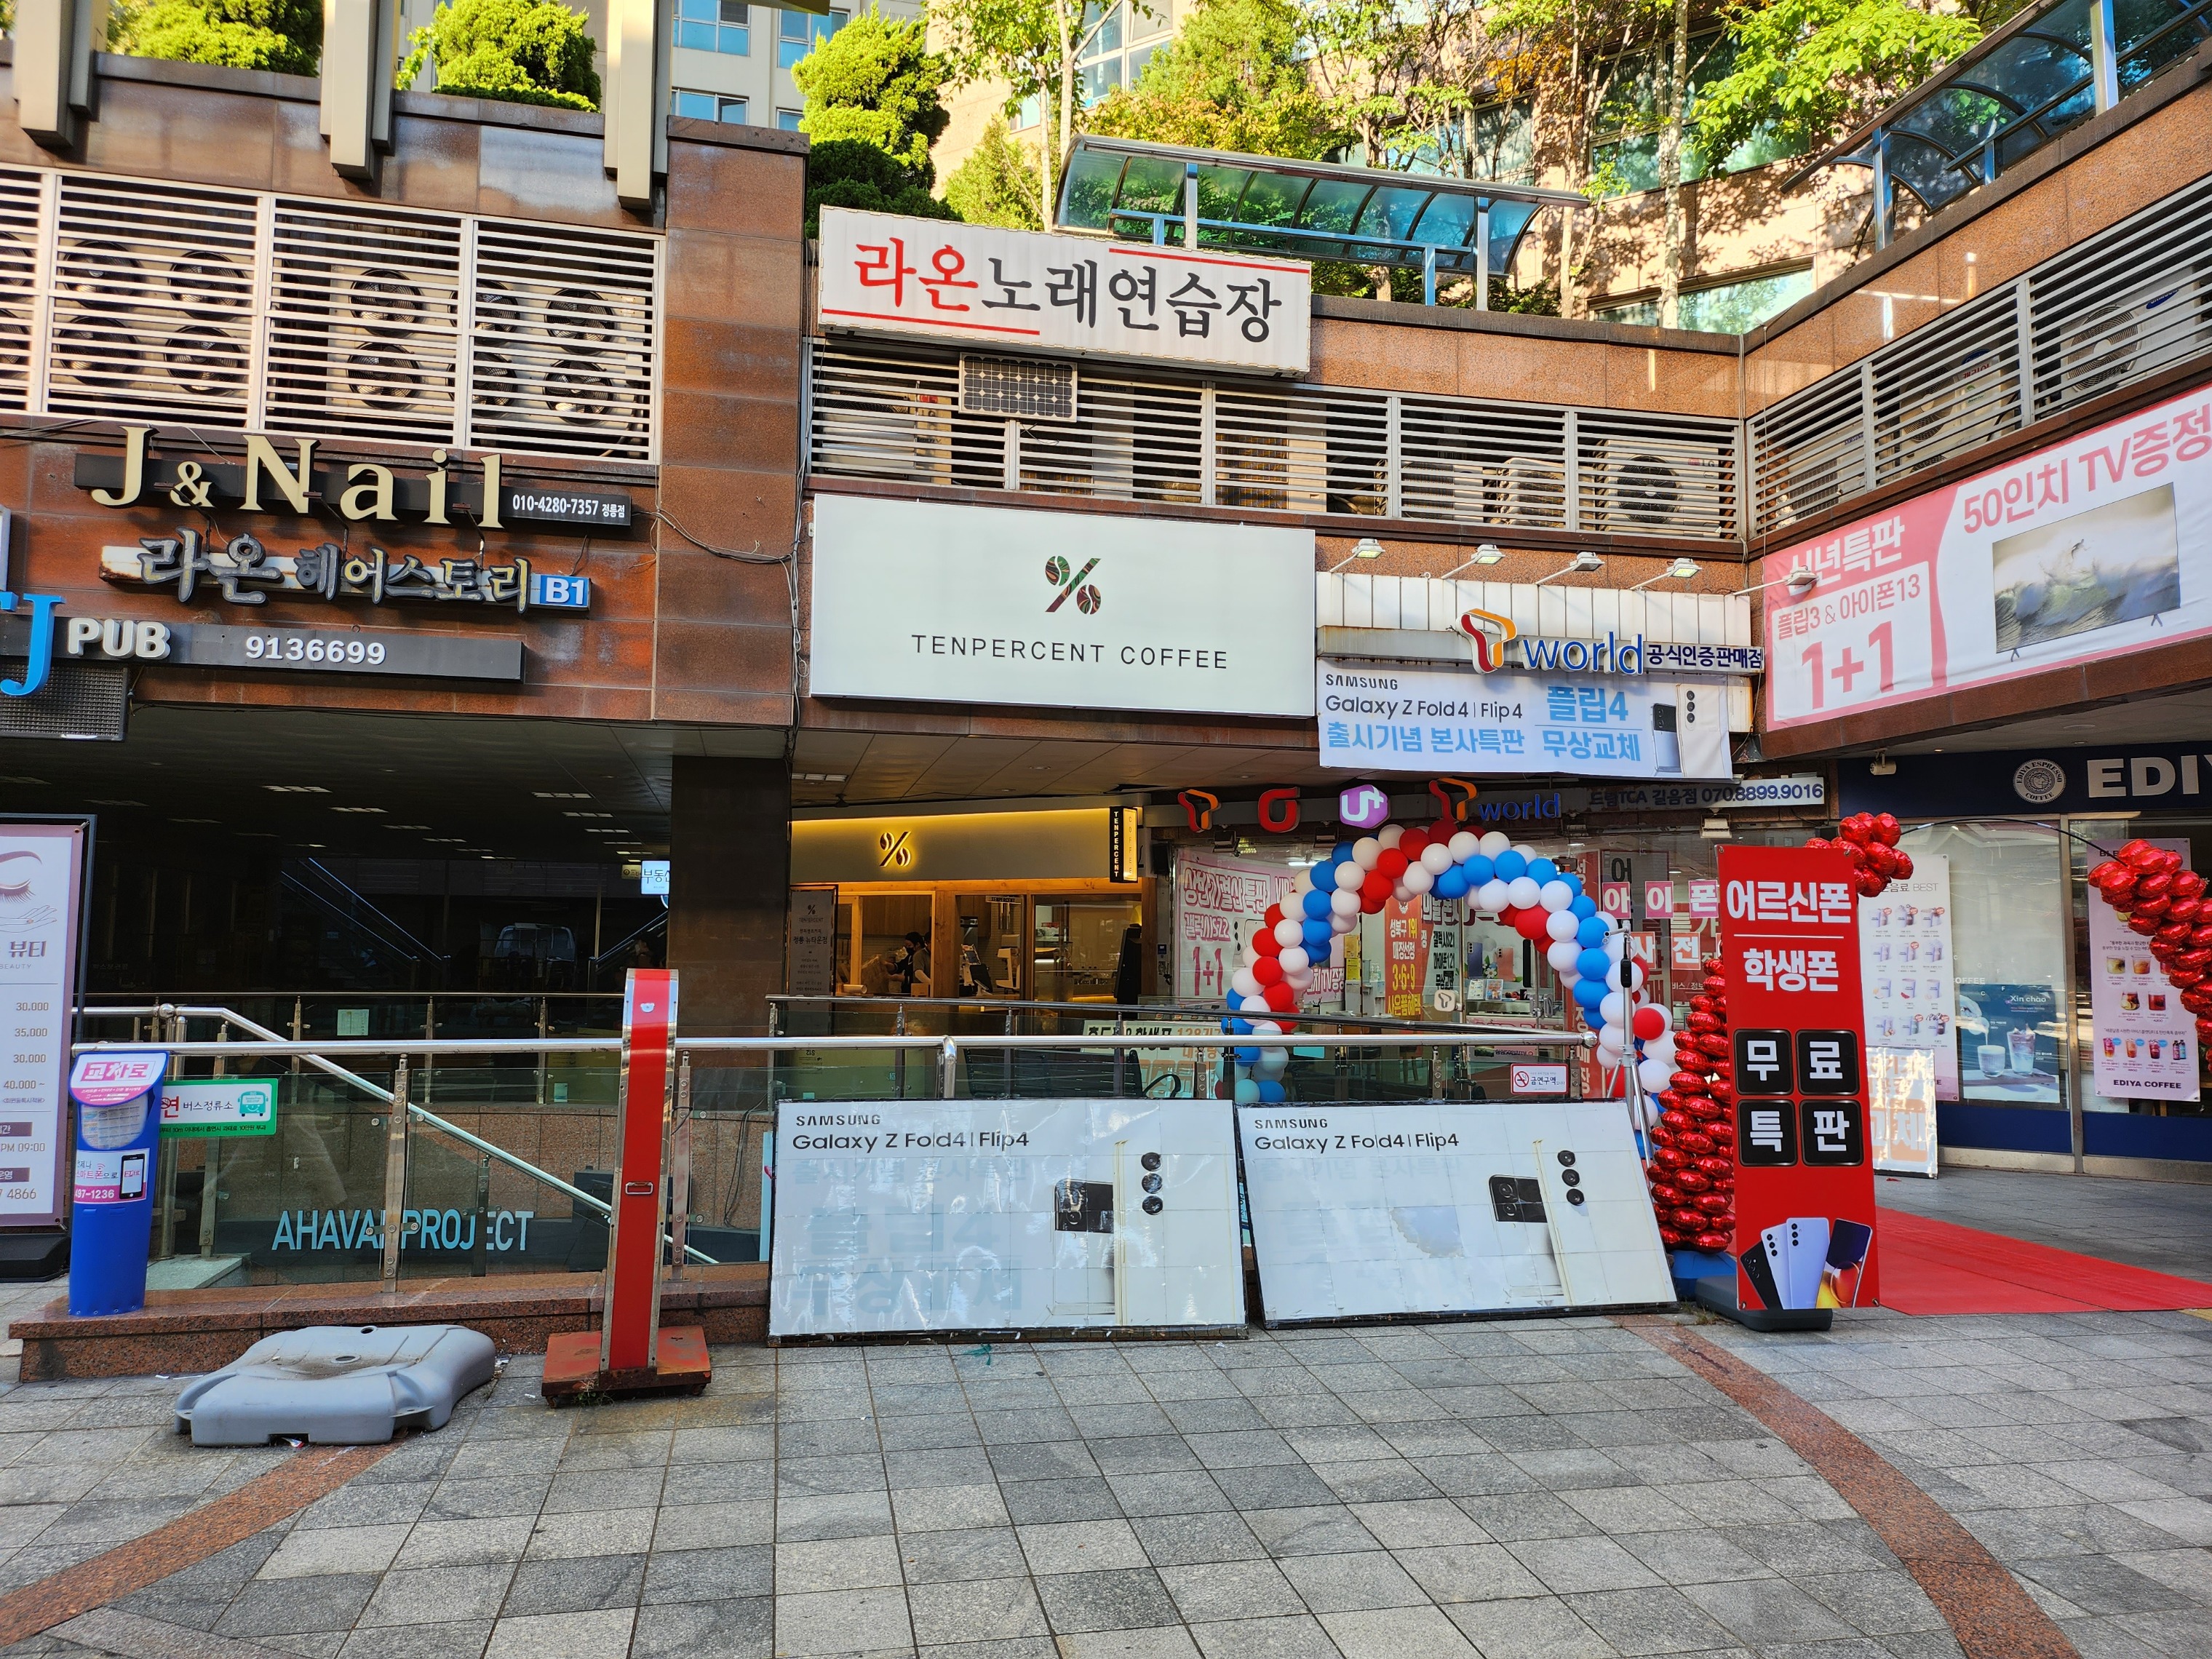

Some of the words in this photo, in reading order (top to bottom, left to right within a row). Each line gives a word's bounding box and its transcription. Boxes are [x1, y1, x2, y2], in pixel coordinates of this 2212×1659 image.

[240, 434, 505, 529] Nail
[512, 494, 600, 516] 010-4280-7357
[602, 501, 626, 519] 정릉점
[1964, 459, 2069, 534] 50인치
[545, 578, 586, 607] B1
[1778, 606, 1820, 640] 플립3
[68, 618, 171, 659] PUB
[245, 636, 386, 665] 9136699
[911, 634, 1105, 664] TENPERCENT
[1121, 647, 1228, 669] COFFEE
[1523, 631, 1644, 675] world
[1646, 644, 1764, 669] 공식인증판매점
[1802, 621, 1893, 709] 1+1
[1325, 674, 1398, 690] SAMSUNG
[1325, 695, 1398, 720] Galaxy
[1402, 699, 1413, 715] Z
[1547, 685, 1628, 723] 플립4
[1327, 722, 1423, 753] 출시기념
[1431, 727, 1524, 755] 본사특판
[1542, 730, 1641, 762] 무상교체
[2088, 755, 2212, 798] EDI
[1478, 792, 1561, 821] world
[1652, 788, 1698, 805] 길음점
[1701, 783, 1823, 802] 070.8899.9016
[2025, 792, 2054, 800] COFFEE
[1913, 883, 1939, 892] BEST
[1726, 880, 1852, 924] 어르신폰
[1390, 919, 1407, 938] 성북구
[1409, 918, 1417, 939] 1위
[9, 940, 47, 958] 뷰티
[1743, 948, 1839, 992] 학생폰
[15, 1028, 47, 1038] 35,000
[81, 1062, 150, 1081] 교차로
[1531, 1077, 1556, 1085] 금연구역
[2113, 1079, 2141, 1087] EDIYA
[2144, 1081, 2181, 1089] COFFEE
[183, 1101, 234, 1111] 버스정류소
[795, 1114, 881, 1127] SAMSUNG
[1254, 1118, 1329, 1129] SAMSUNG
[18, 1143, 45, 1152] 09:00
[792, 1134, 877, 1154] Galaxy
[885, 1134, 899, 1149] Z
[1254, 1137, 1329, 1154] Galaxy
[1334, 1136, 1347, 1150] Z
[7, 1188, 36, 1200] 4866
[271, 1209, 386, 1250] AHAVA
